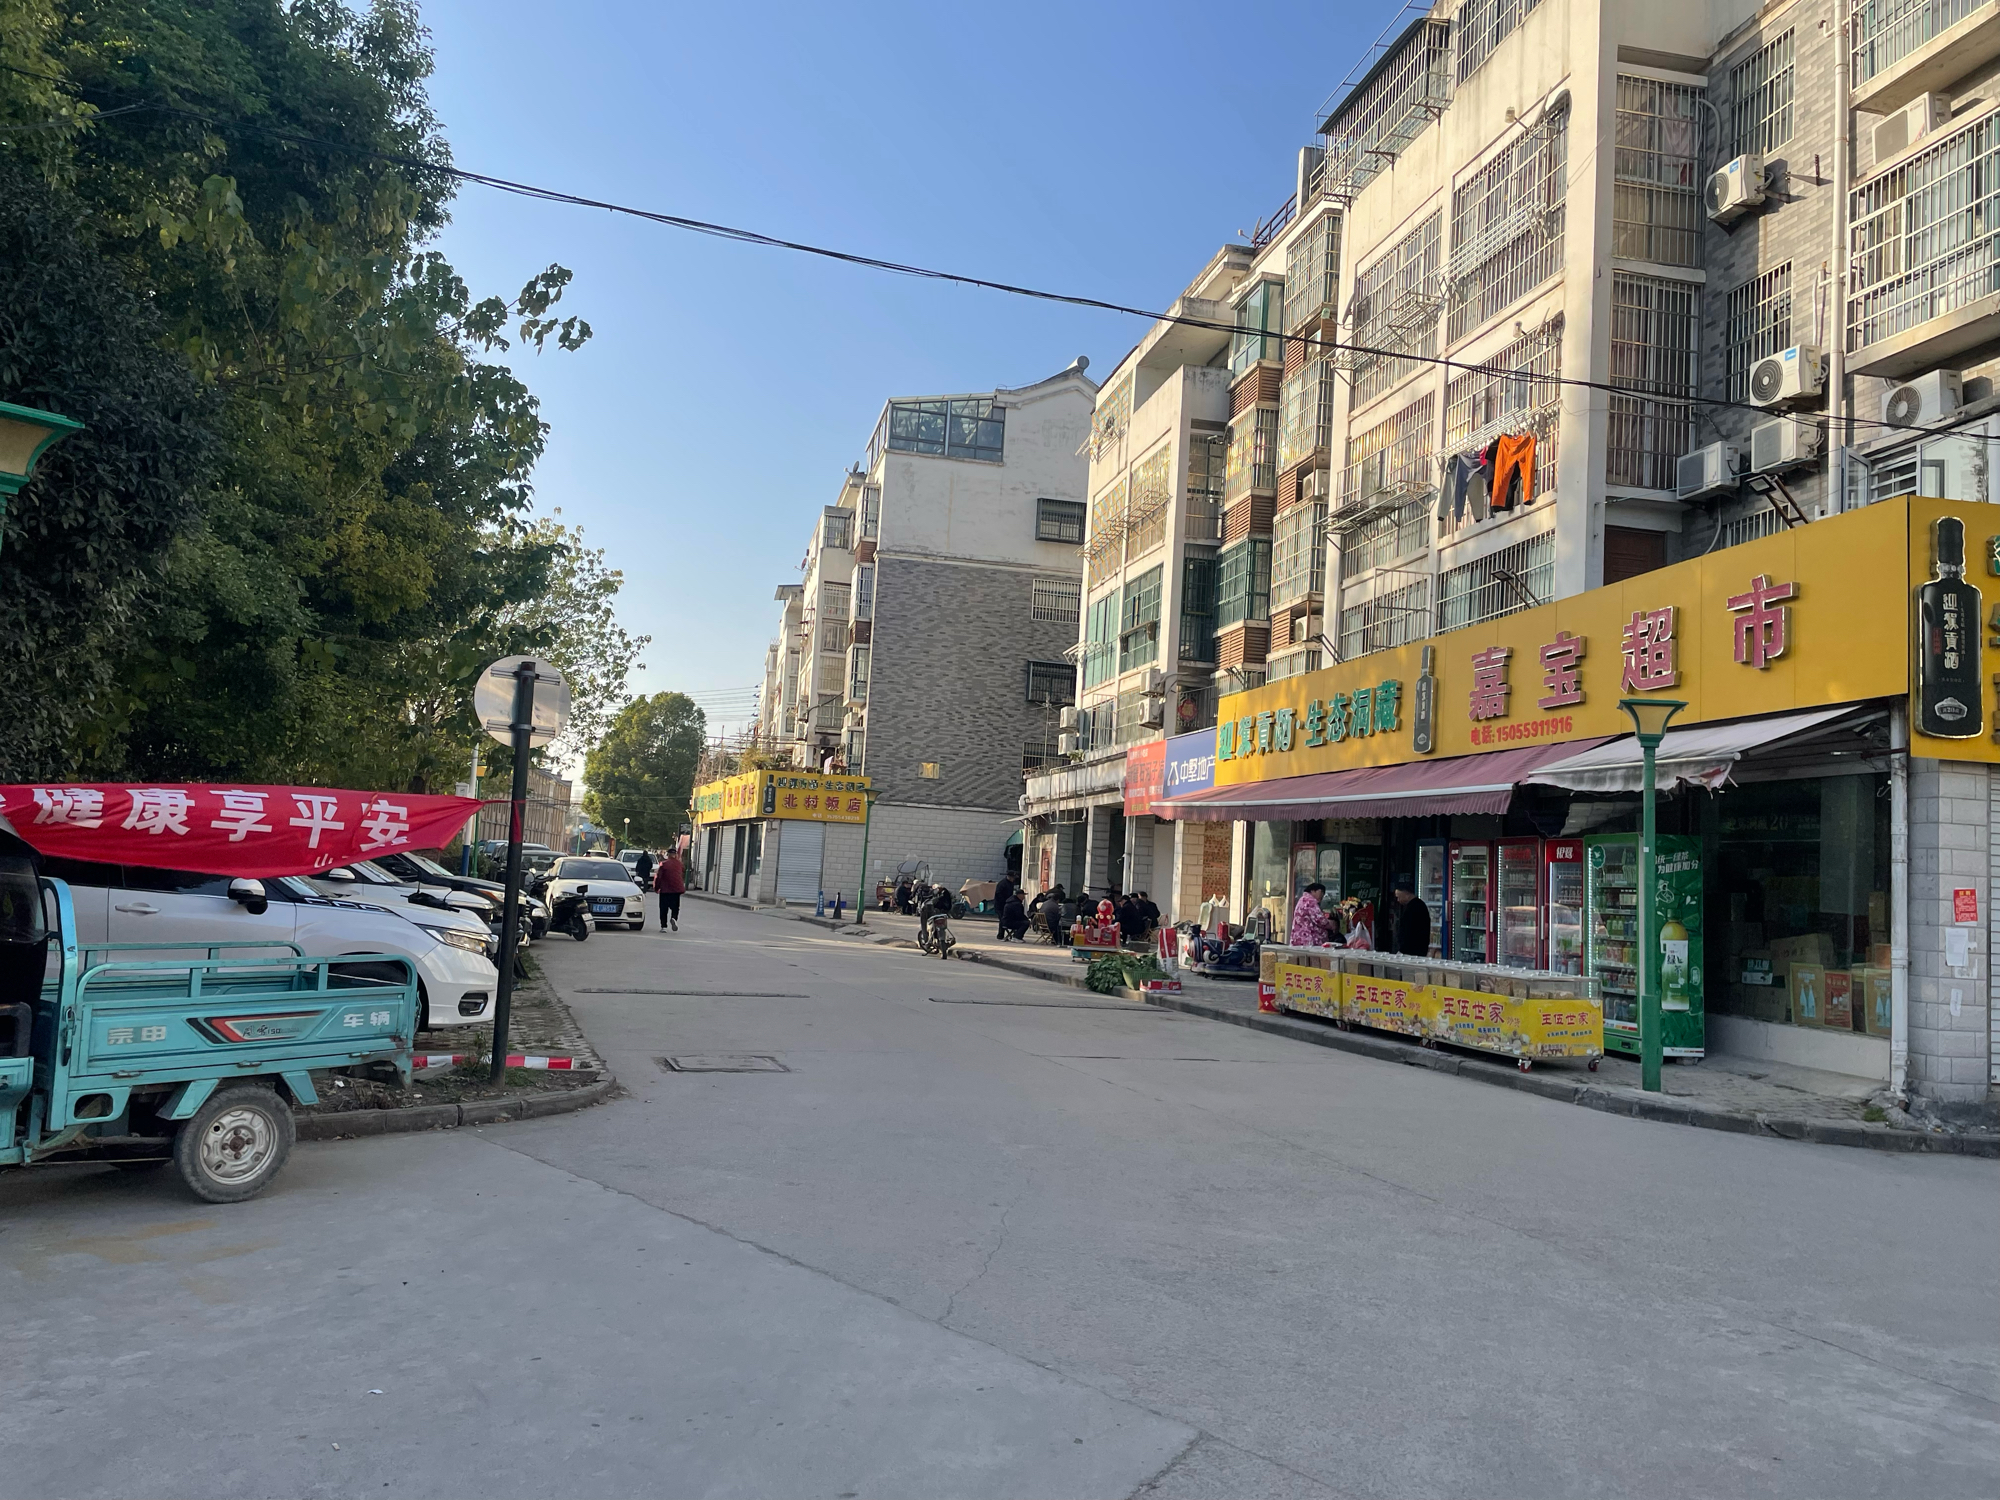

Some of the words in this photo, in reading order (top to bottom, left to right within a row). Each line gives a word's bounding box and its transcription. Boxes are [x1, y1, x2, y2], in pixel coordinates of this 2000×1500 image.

[1469, 574, 1800, 722] 嘉宝超市
[1180, 755, 1216, 783] 中墅地产
[0, 786, 410, 852] 健康享平安
[1654, 851, 1690, 867] 统一绿茶
[1657, 859, 1700, 876] 为健康加分
[1285, 972, 1324, 994] 王伍世家
[1355, 985, 1407, 1009] 王伍世家
[343, 1010, 390, 1028] 车辆
[1443, 997, 1505, 1024] 王伍世家
[1541, 1011, 1589, 1026] 王伍世家
[108, 1025, 167, 1046] 宗申
